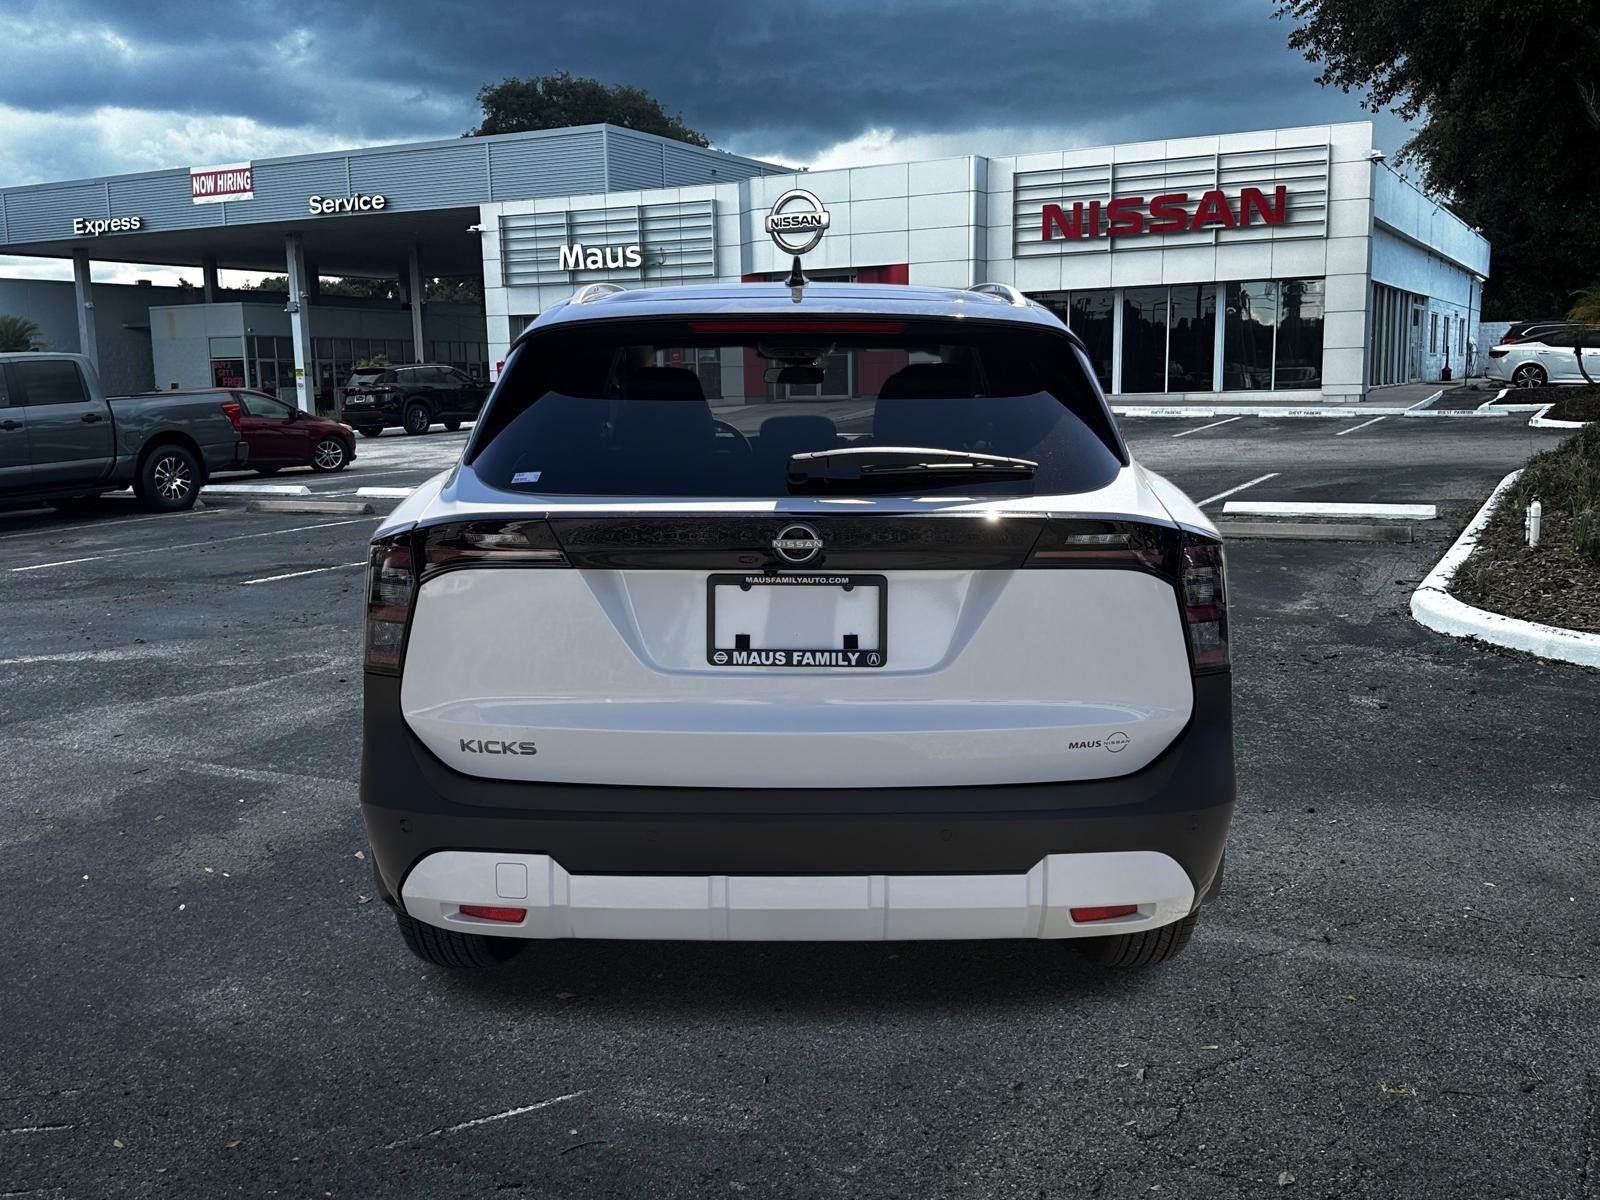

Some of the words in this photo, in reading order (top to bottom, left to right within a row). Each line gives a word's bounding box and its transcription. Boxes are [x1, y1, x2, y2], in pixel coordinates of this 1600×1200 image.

[192, 174, 215, 195] NOW
[217, 171, 251, 193] HIRING
[309, 193, 385, 215] Service
[770, 214, 822, 229] NISSAN
[1042, 185, 1287, 241] NISSAN
[73, 216, 141, 237] Express
[559, 243, 642, 271] Maus
[773, 540, 823, 548] NISSAN
[745, 576, 849, 584] MAUSFAMILYAUTO.COM
[732, 651, 786, 665] MAUS
[792, 652, 860, 666] FAMILY
[460, 738, 537, 755] KICKS
[1068, 740, 1102, 750] MAUS
